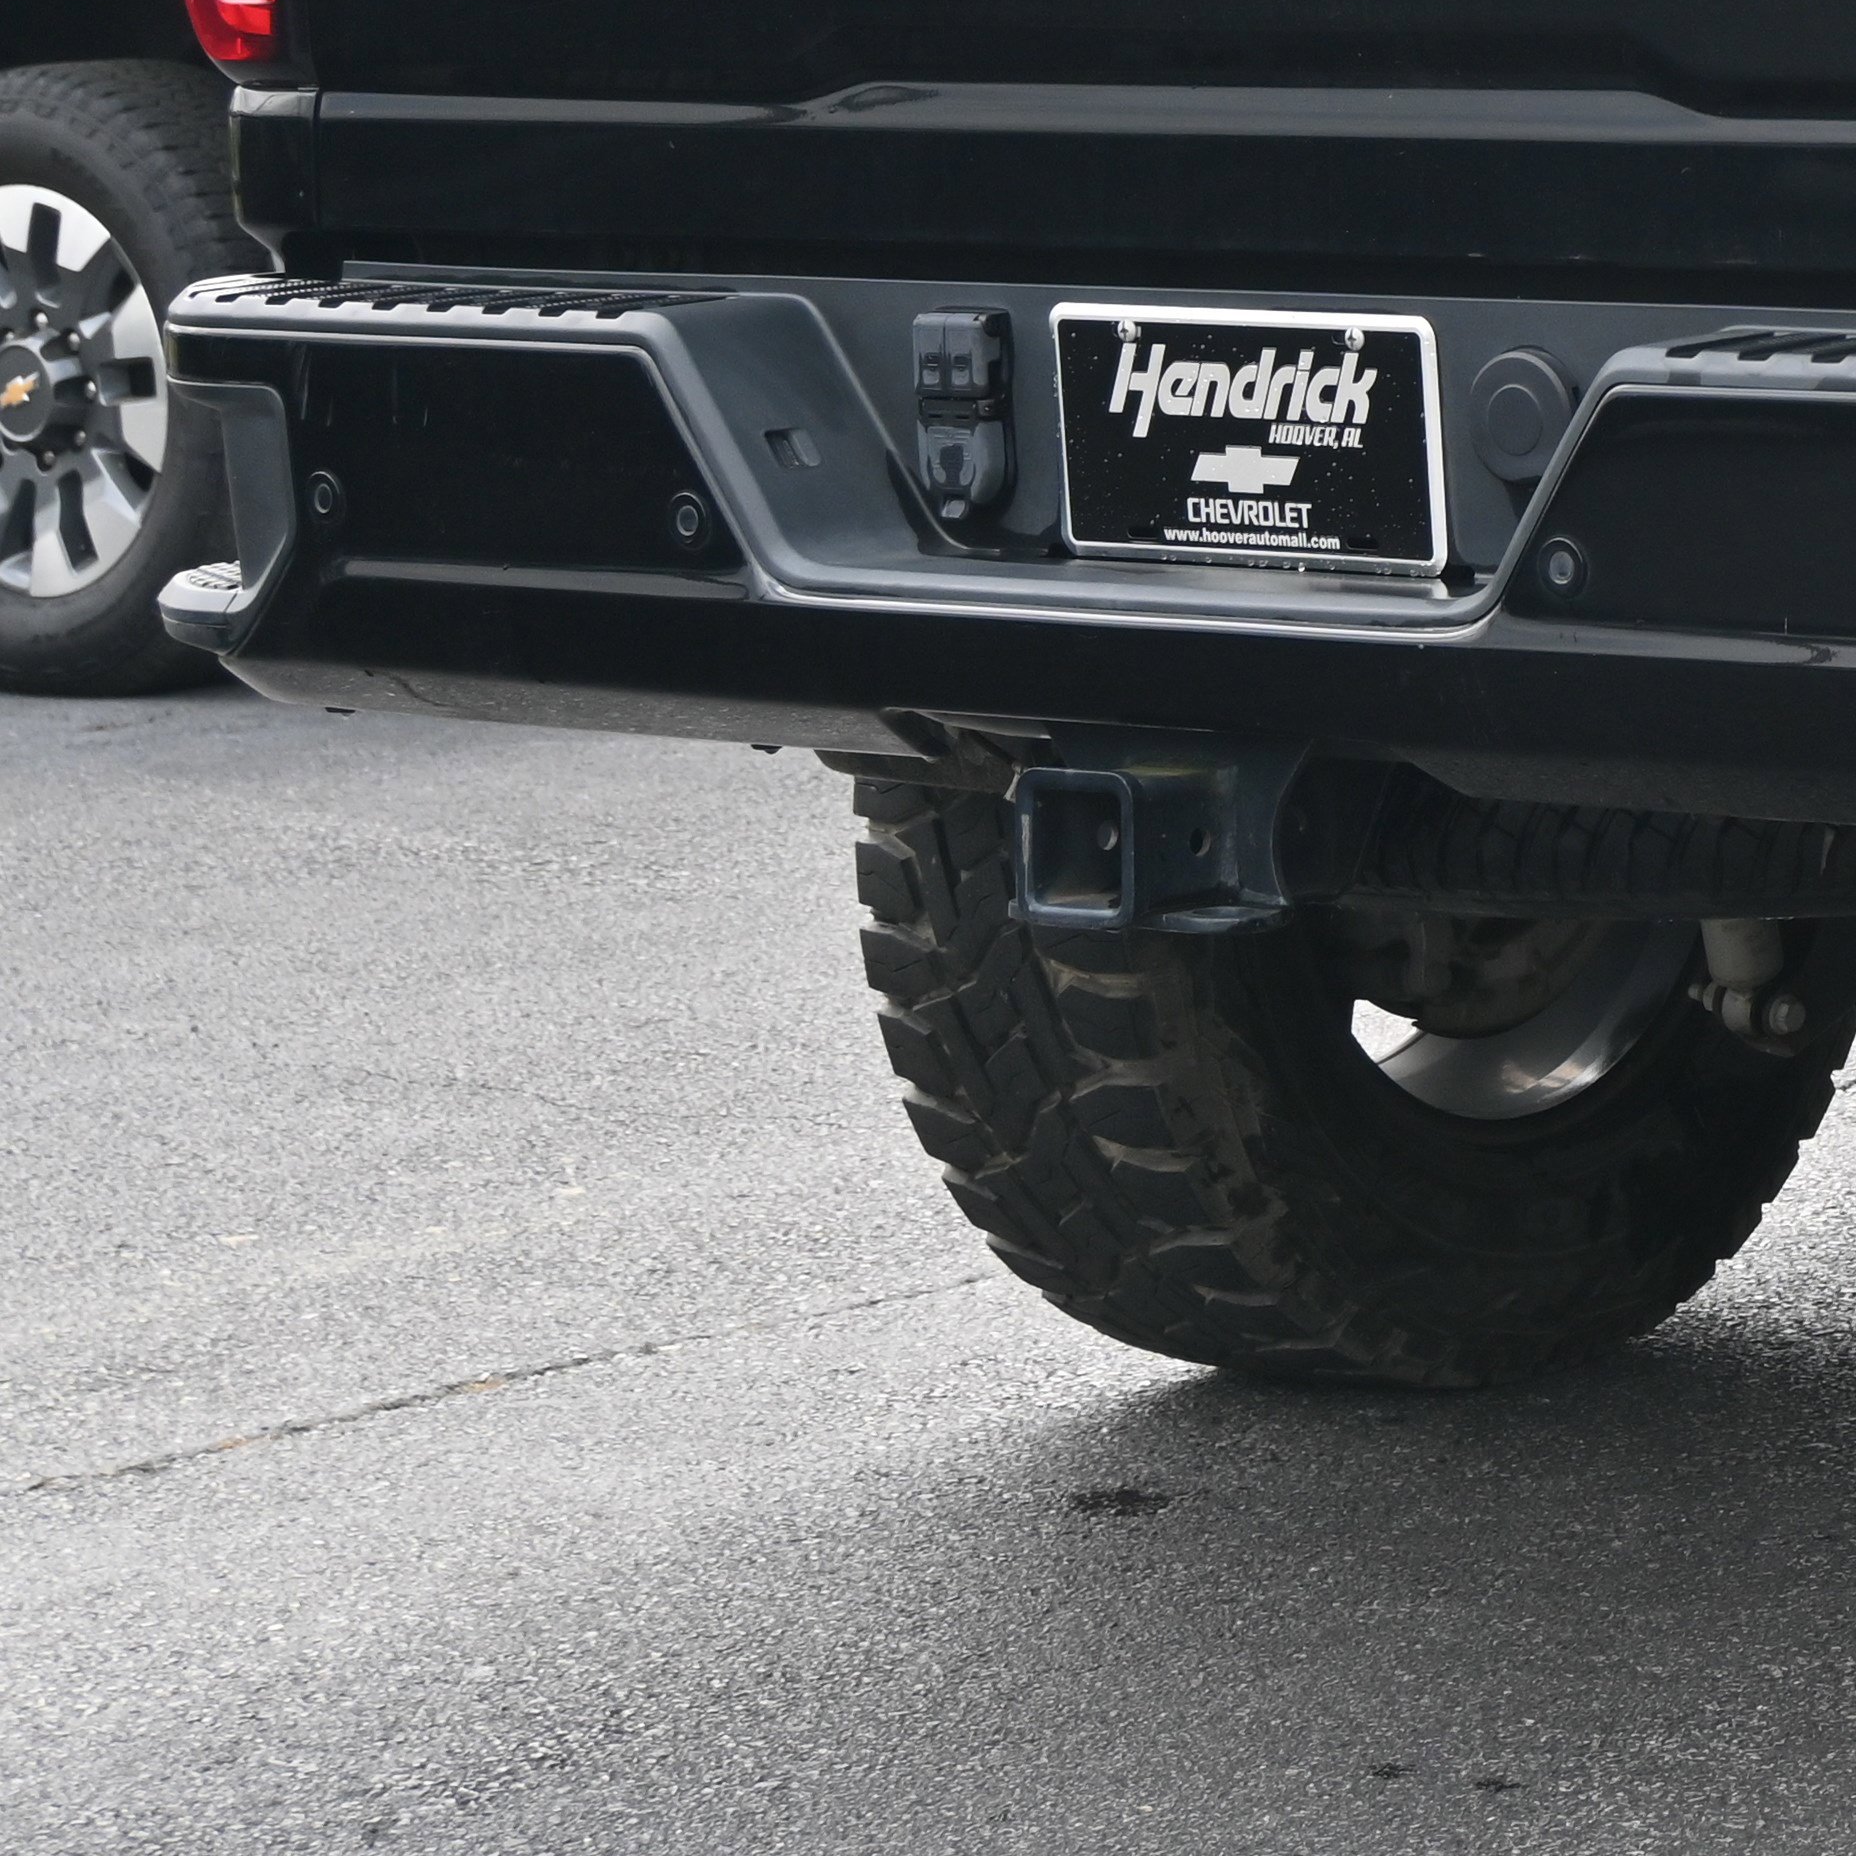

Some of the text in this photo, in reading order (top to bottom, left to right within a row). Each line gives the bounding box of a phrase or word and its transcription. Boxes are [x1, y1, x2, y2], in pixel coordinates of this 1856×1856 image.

[1109, 342, 1379, 438] Hendrick
[1269, 423, 1364, 448] HOOVER, AL
[1187, 497, 1312, 529] CHEVROLET
[1164, 526, 1341, 550] www.hooverautomall.com
